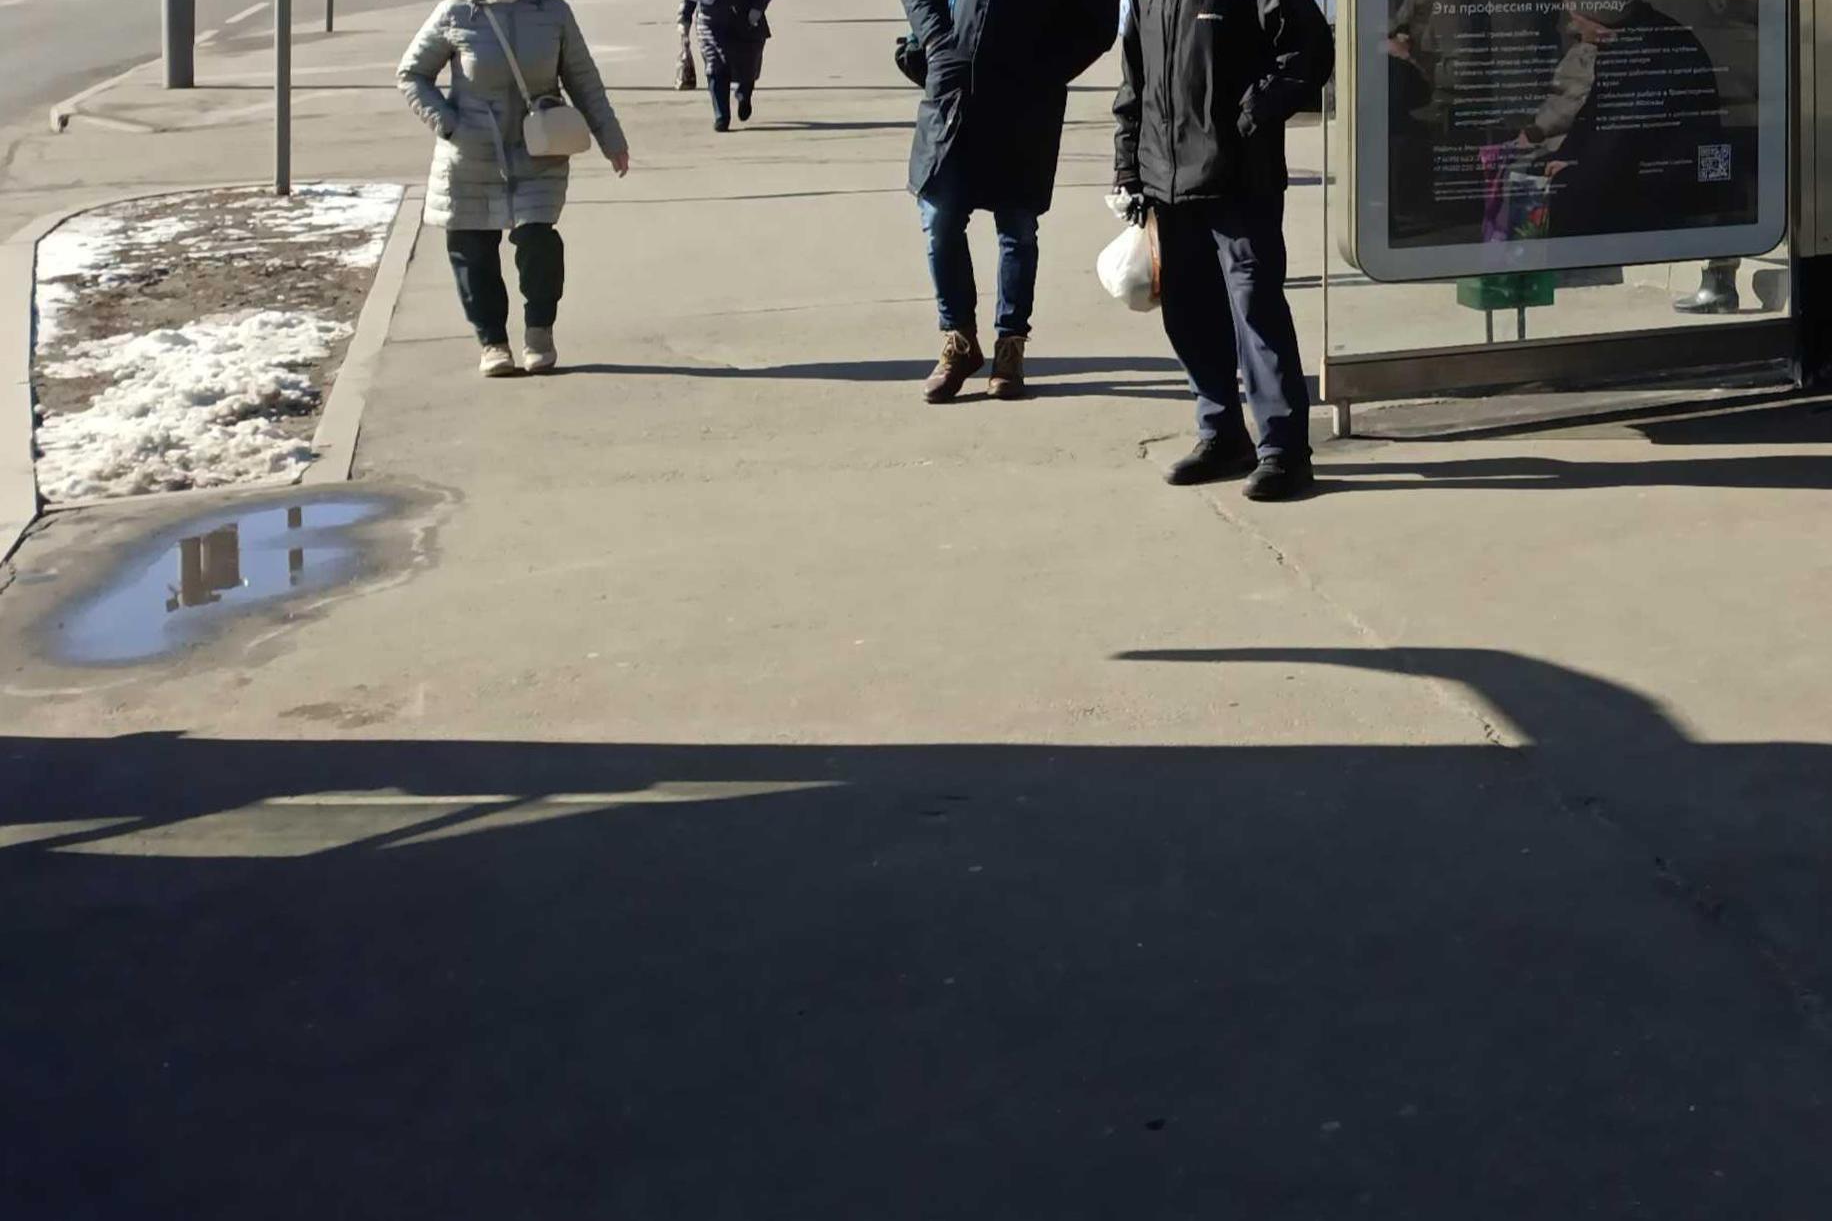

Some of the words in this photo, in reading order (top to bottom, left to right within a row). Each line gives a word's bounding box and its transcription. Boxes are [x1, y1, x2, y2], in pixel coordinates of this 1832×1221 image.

[1432, 1, 1456, 15] Эта
[1459, 0, 1532, 17] профессия
[1536, 1, 1577, 14] нужна
[1580, 0, 1626, 13] городу
